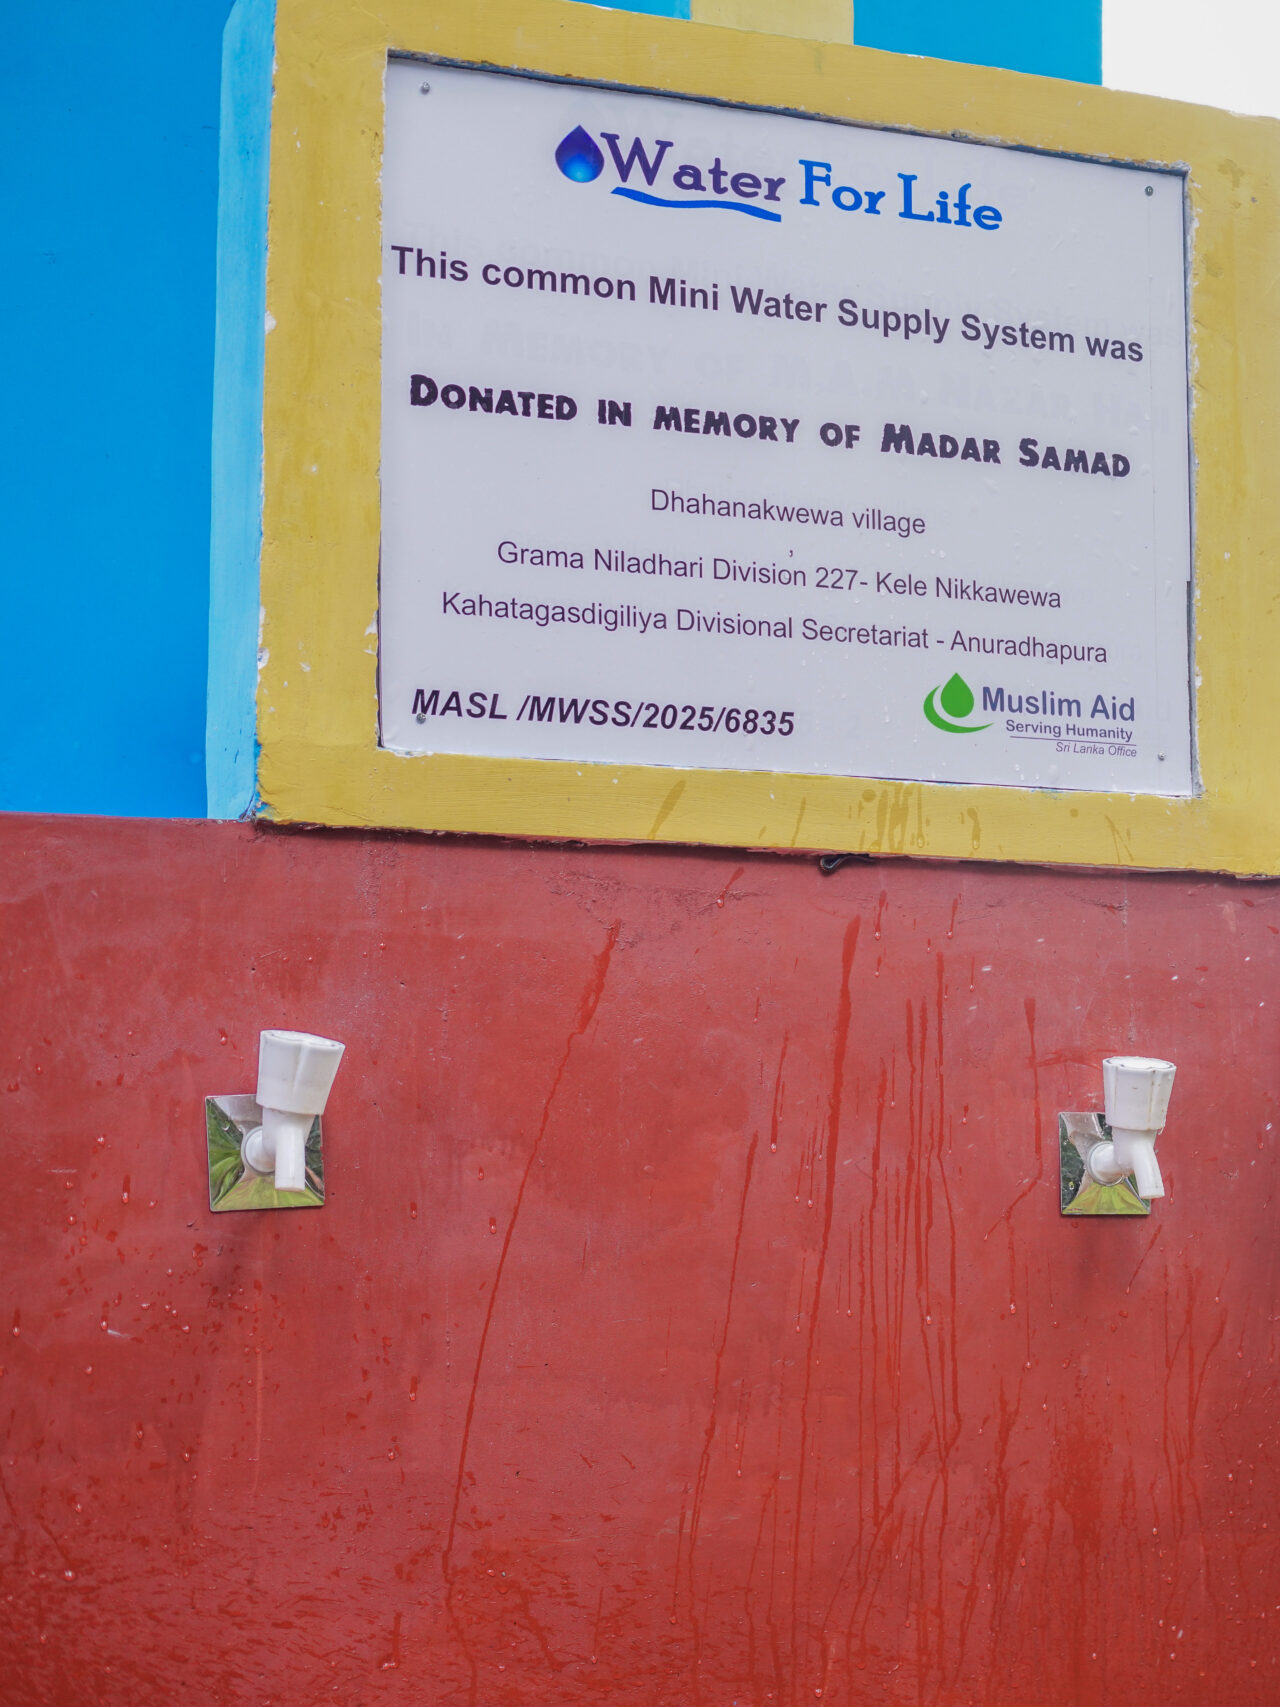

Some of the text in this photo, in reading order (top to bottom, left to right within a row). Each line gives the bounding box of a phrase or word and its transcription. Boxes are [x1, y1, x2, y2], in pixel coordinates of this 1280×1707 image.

[600, 132, 1002, 230] Water For Life
[391, 245, 1143, 362] This common Mini Water Supply System was
[652, 489, 925, 538] Dhahanakwewa village
[498, 541, 584, 569] Grama
[595, 549, 702, 578] Niladhari
[714, 556, 806, 587] Division
[877, 572, 927, 596] Kele
[936, 577, 1060, 608] Nikkawewa
[443, 592, 667, 633] Kahatagasdigiliya
[677, 609, 792, 638] Divisional
[802, 618, 928, 648] Secretariat
[950, 630, 1107, 664] Anuradhapura
[412, 688, 794, 736] MASL /MWSS/2025/6835
[982, 686, 1134, 721] Muslim Aid
[1006, 719, 1133, 743] Serving Humanity
[1056, 741, 1137, 758] Sri Lanka Office
